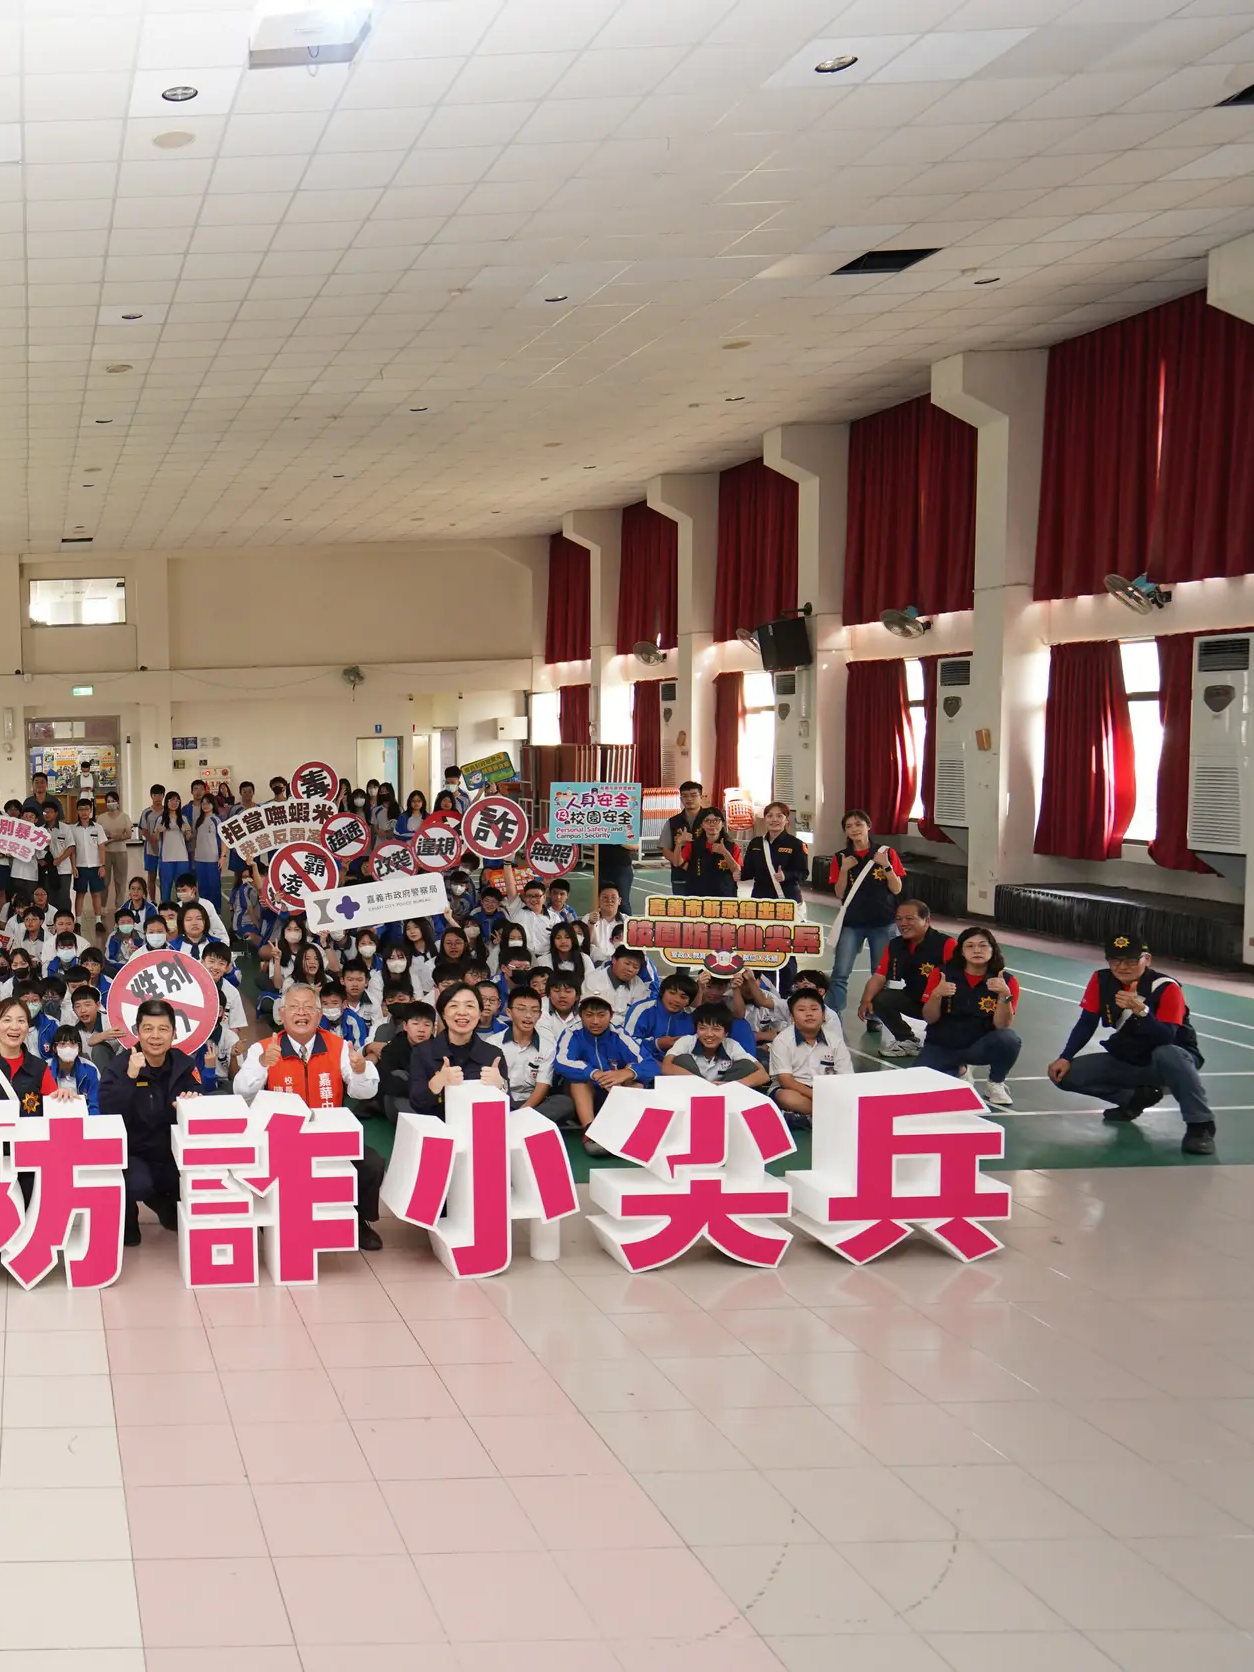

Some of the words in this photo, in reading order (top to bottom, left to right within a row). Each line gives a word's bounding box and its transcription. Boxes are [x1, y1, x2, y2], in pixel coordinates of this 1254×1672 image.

[300, 769, 331, 799] 毒
[567, 793, 630, 809] 人身安全
[221, 803, 334, 845] 拒當嘸蝦米
[326, 820, 365, 853] 超速
[474, 806, 519, 848] 詐
[416, 836, 456, 856] 違規
[530, 841, 572, 865] 無照
[303, 852, 327, 877] 霸
[375, 848, 413, 878] 改裝
[279, 873, 303, 898] 凌
[366, 884, 438, 904] 嘉義市政府警察局
[627, 920, 821, 954] 校園防詐小尖兵
[131, 954, 193, 1000] 性別
